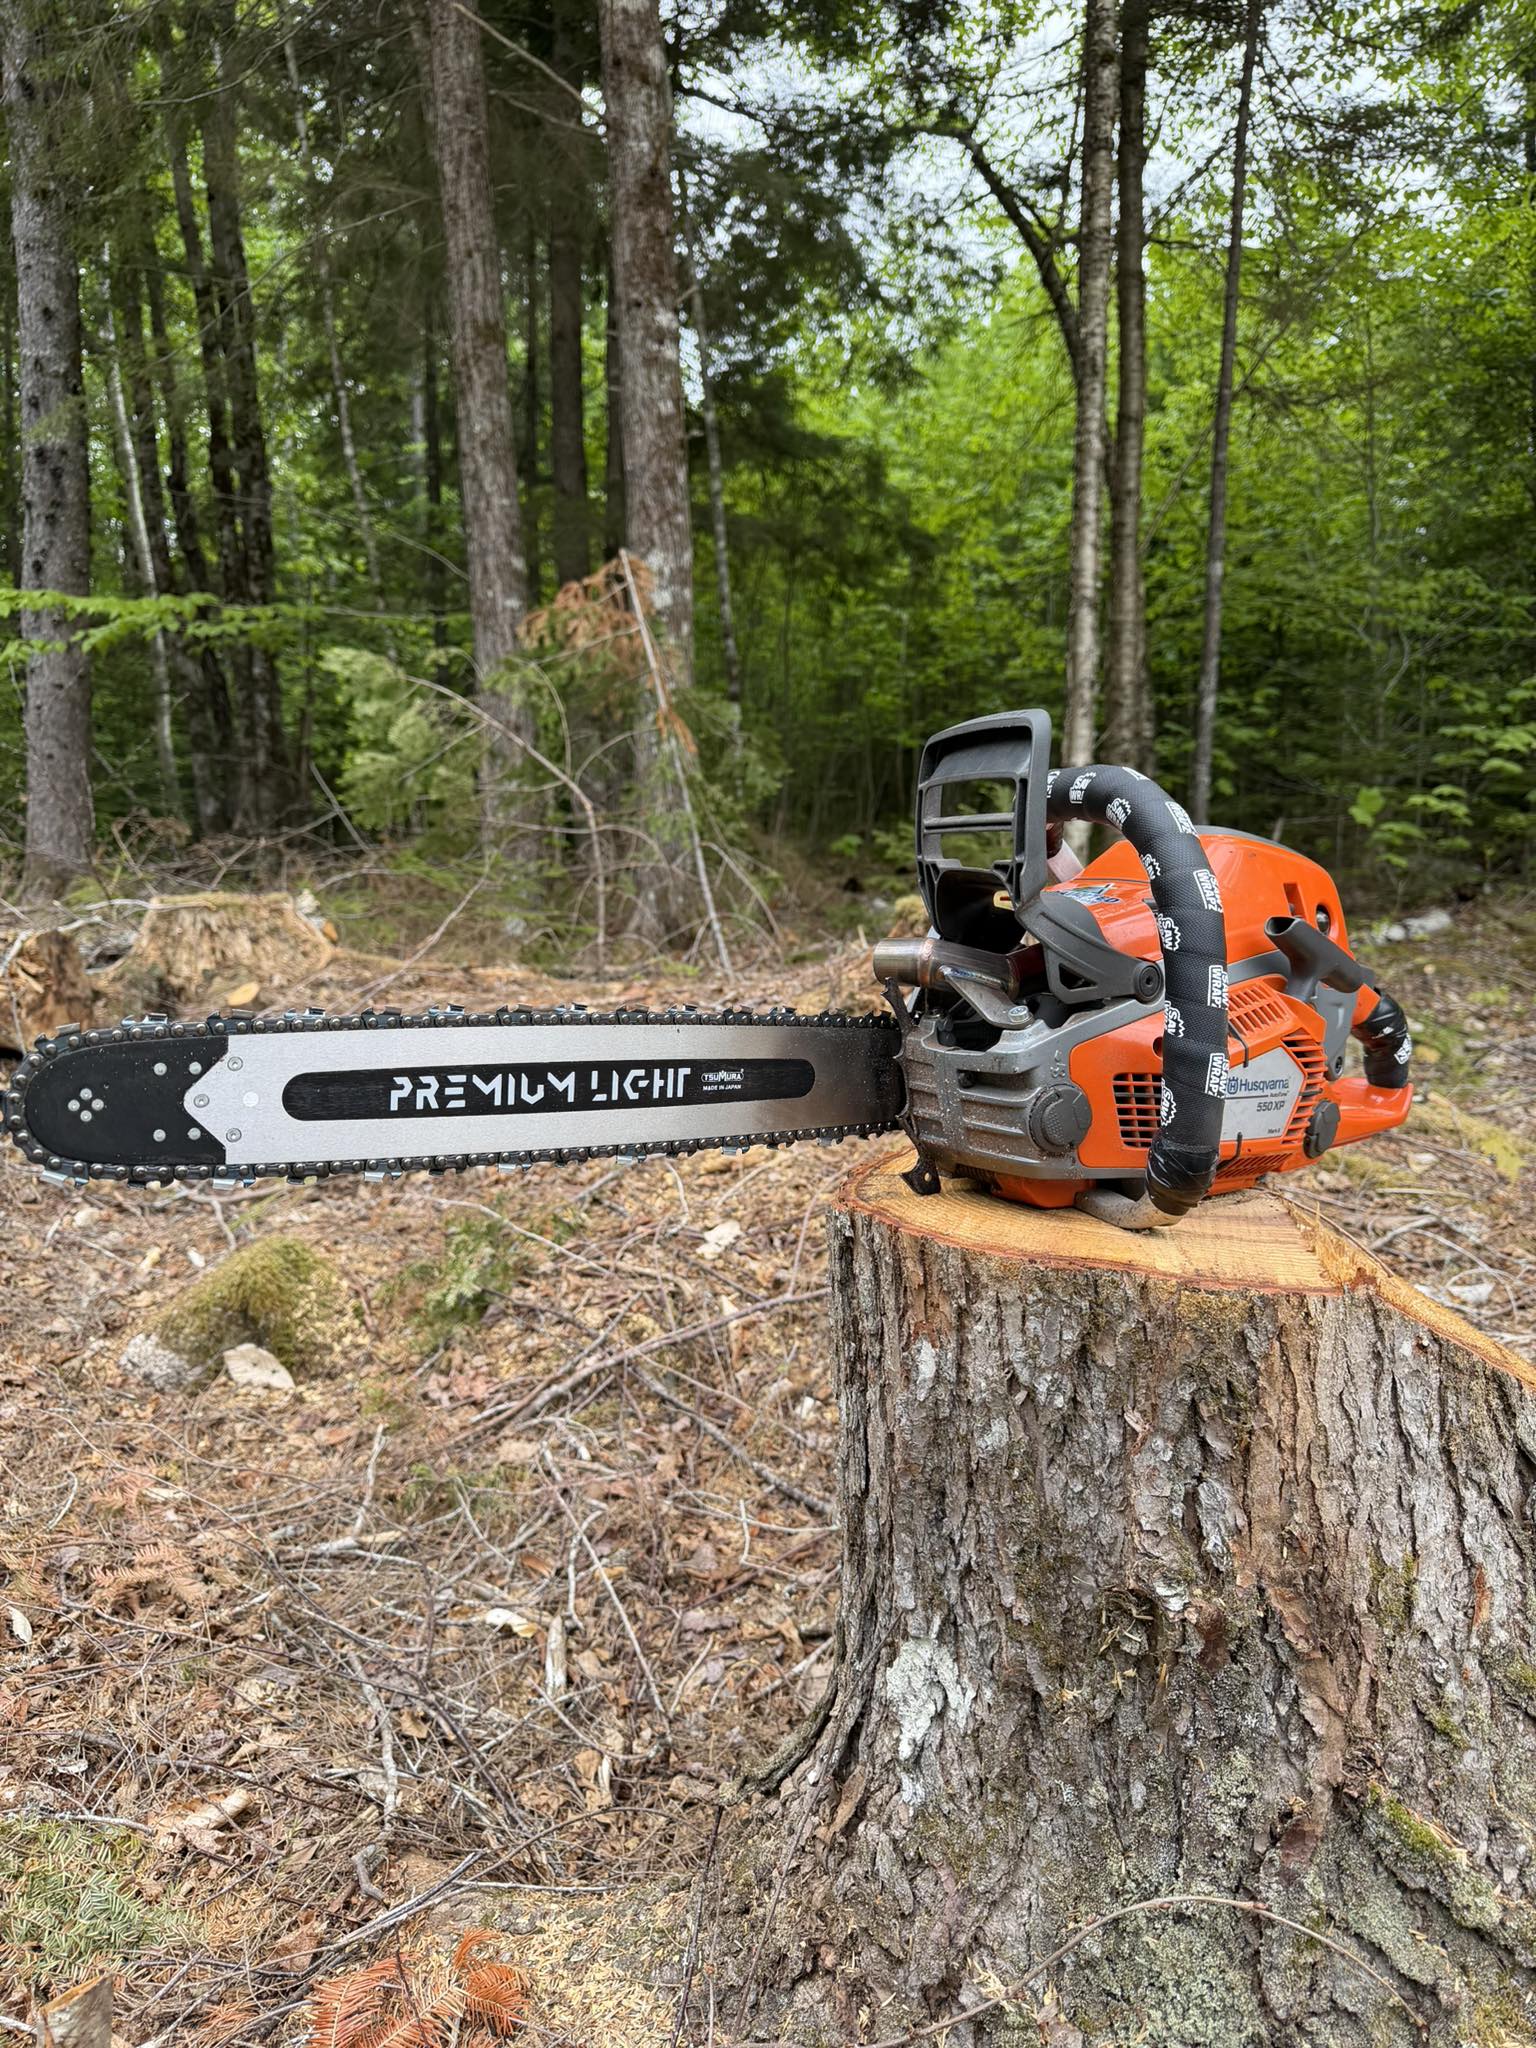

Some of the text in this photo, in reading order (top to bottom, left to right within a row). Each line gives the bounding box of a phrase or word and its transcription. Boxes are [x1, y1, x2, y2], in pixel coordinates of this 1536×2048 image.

[1112, 801, 1127, 824] SAW
[1198, 872, 1218, 911] WRAPZ
[1162, 920, 1173, 951] SAW
[704, 1069, 741, 1081] TSUMURA
[1240, 1078, 1289, 1093] Husqvarna
[390, 1067, 691, 1111] PREMIUM LIGHT
